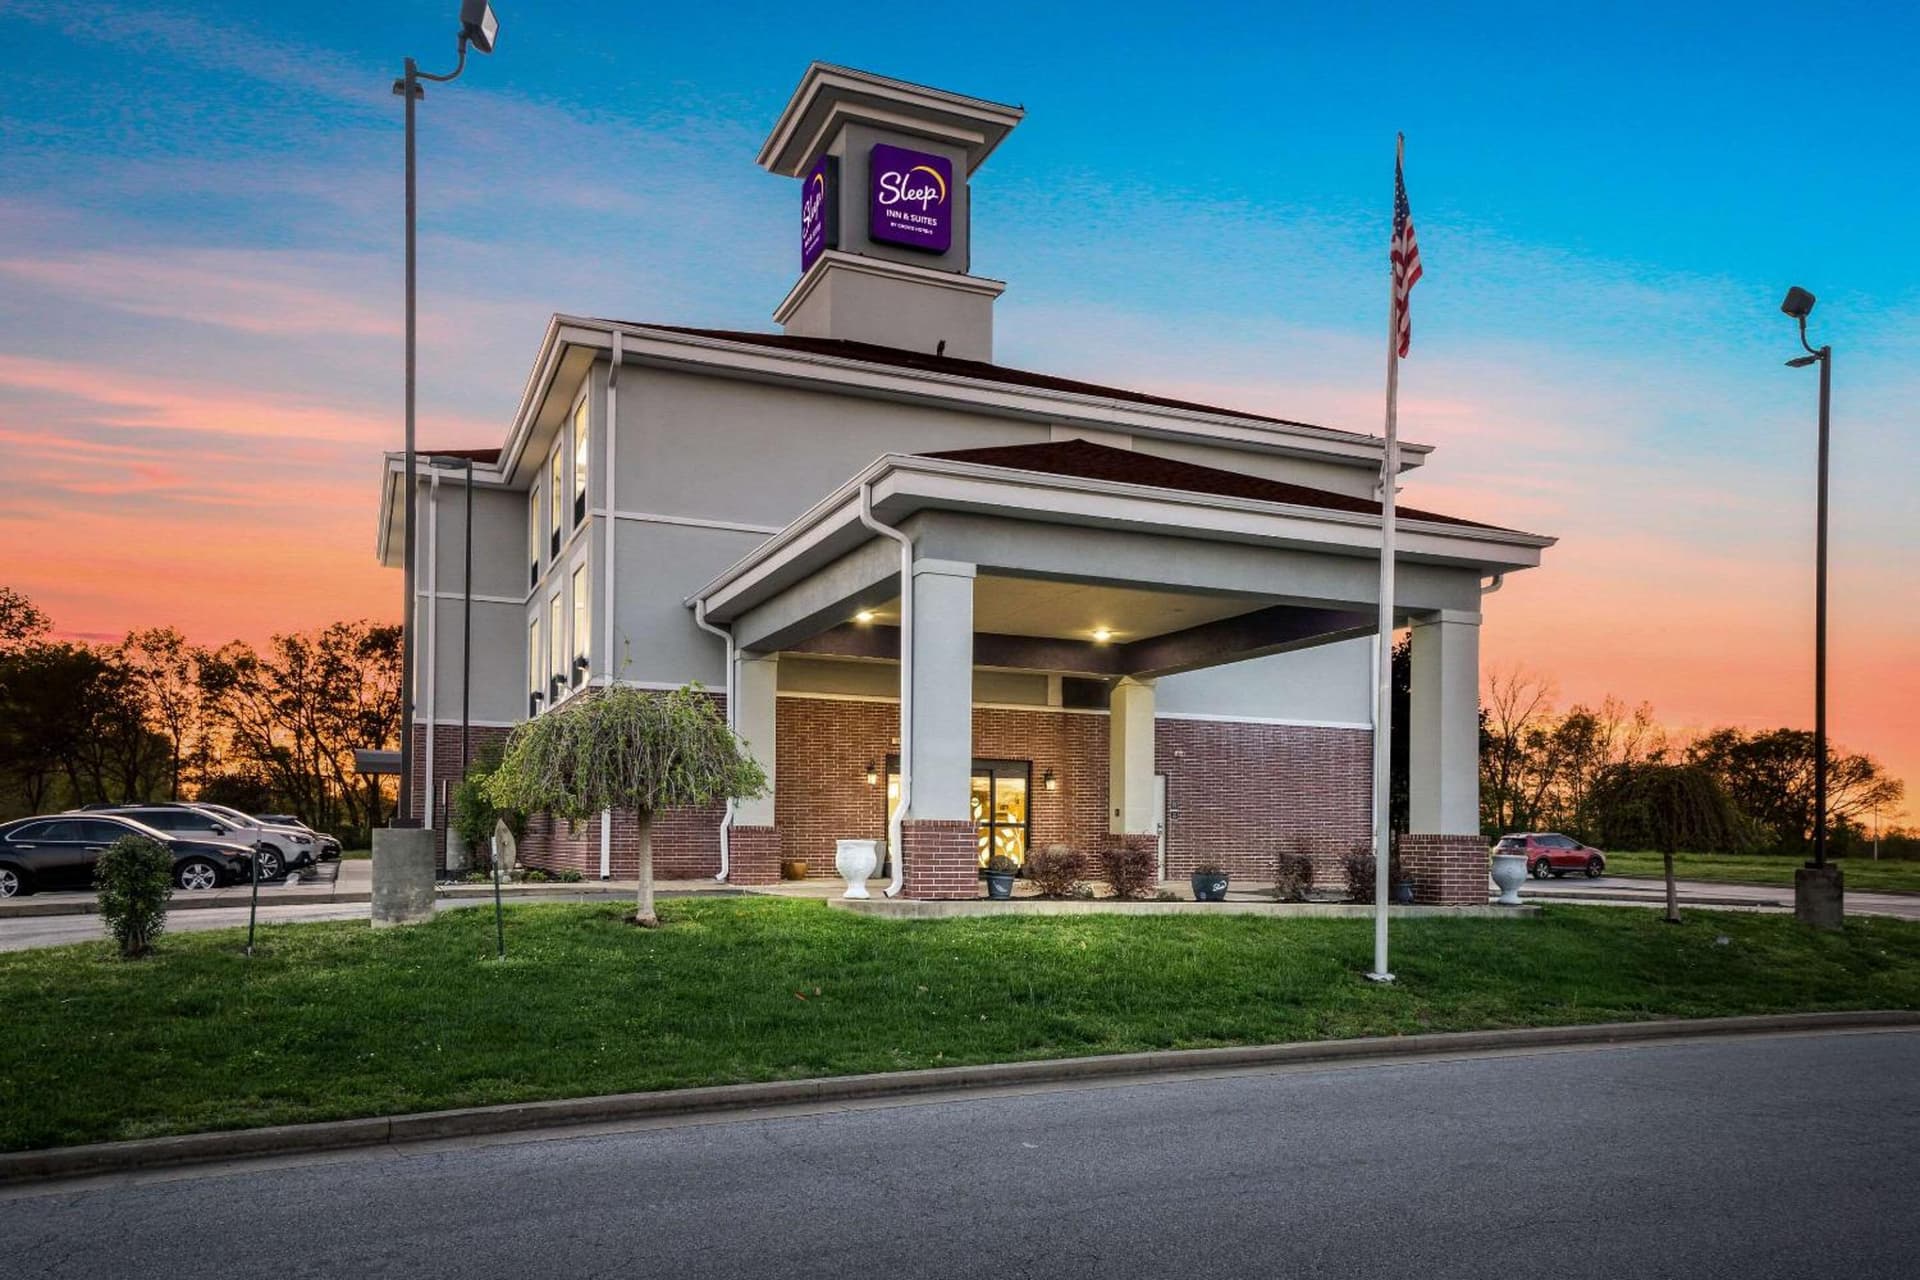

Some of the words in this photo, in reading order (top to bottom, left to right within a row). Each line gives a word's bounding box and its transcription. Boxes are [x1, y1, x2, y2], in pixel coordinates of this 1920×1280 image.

[879, 171, 939, 211] Sleep
[886, 208, 902, 220] INN
[903, 213, 910, 222] &
[910, 214, 938, 226] SUITES
